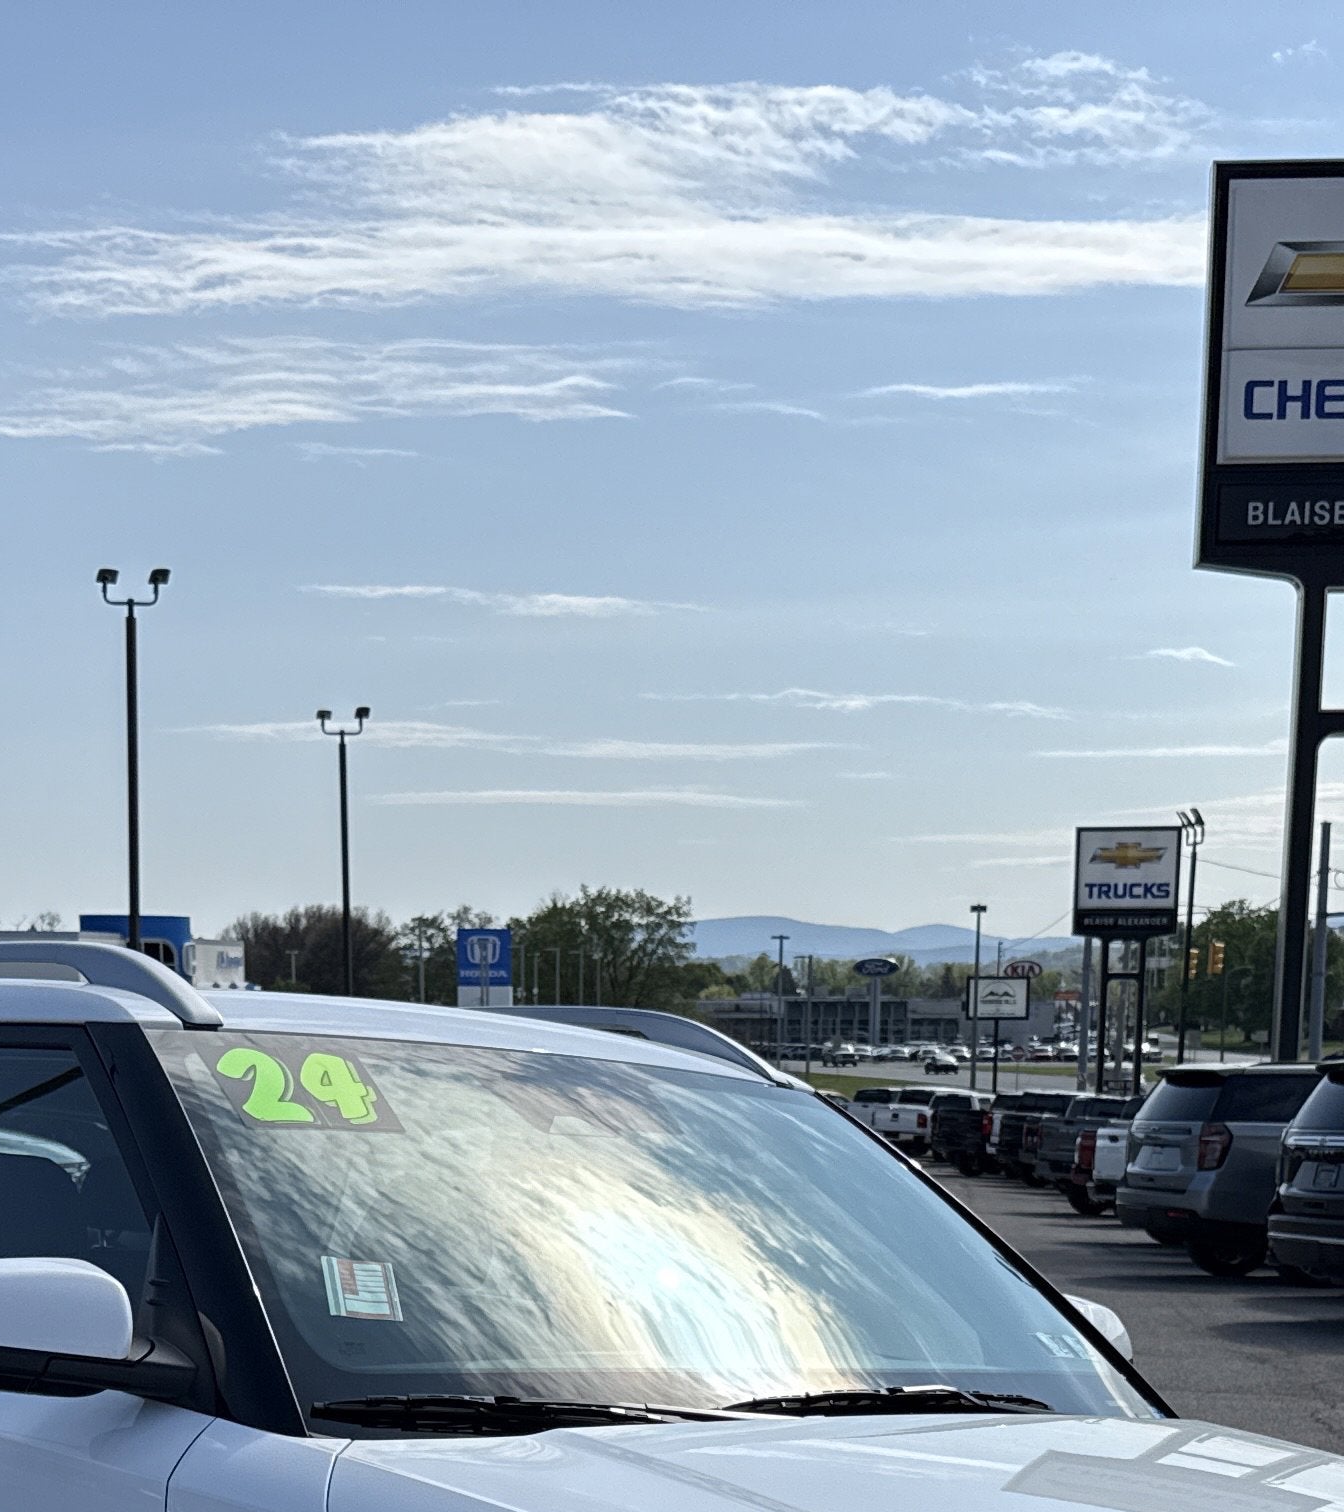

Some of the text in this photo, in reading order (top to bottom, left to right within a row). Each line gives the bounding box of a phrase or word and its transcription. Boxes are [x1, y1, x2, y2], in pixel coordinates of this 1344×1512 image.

[1084, 882, 1171, 899] TRUCKS
[1011, 964, 1035, 978] KIA
[216, 1047, 378, 1125] 24
